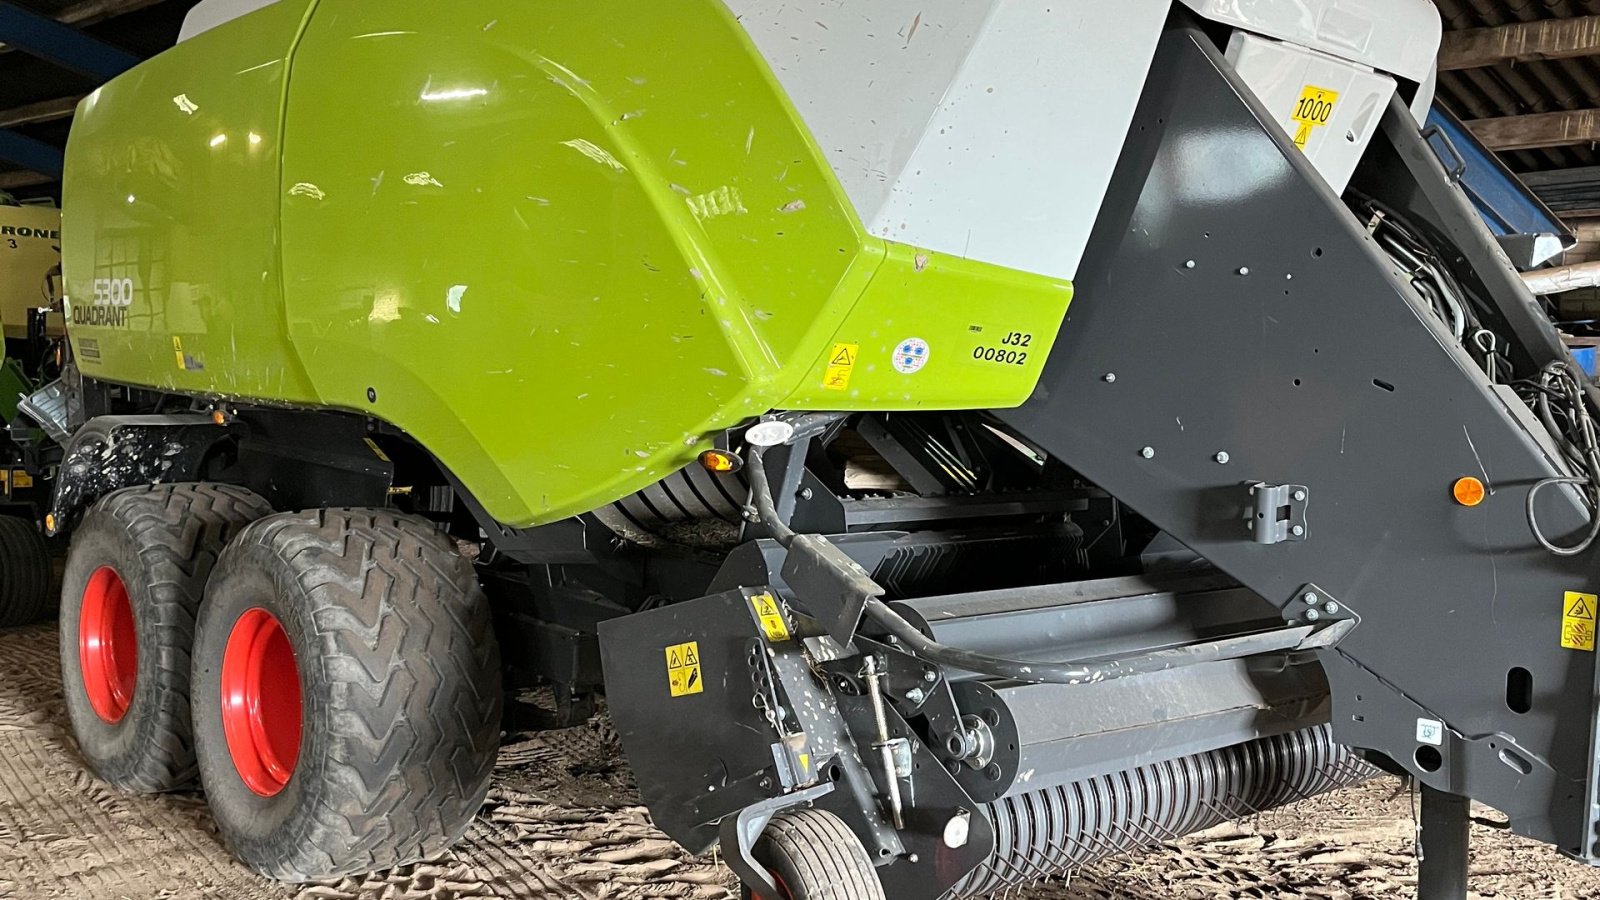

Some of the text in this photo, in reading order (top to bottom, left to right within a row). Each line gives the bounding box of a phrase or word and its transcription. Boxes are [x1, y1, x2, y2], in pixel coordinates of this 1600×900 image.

[1296, 97, 1332, 122] 1000
[7, 238, 18, 249] 3
[94, 278, 133, 305] 5300
[73, 305, 127, 327] QUADRANT
[1001, 332, 1032, 347] J32
[973, 346, 1027, 365] 00802
